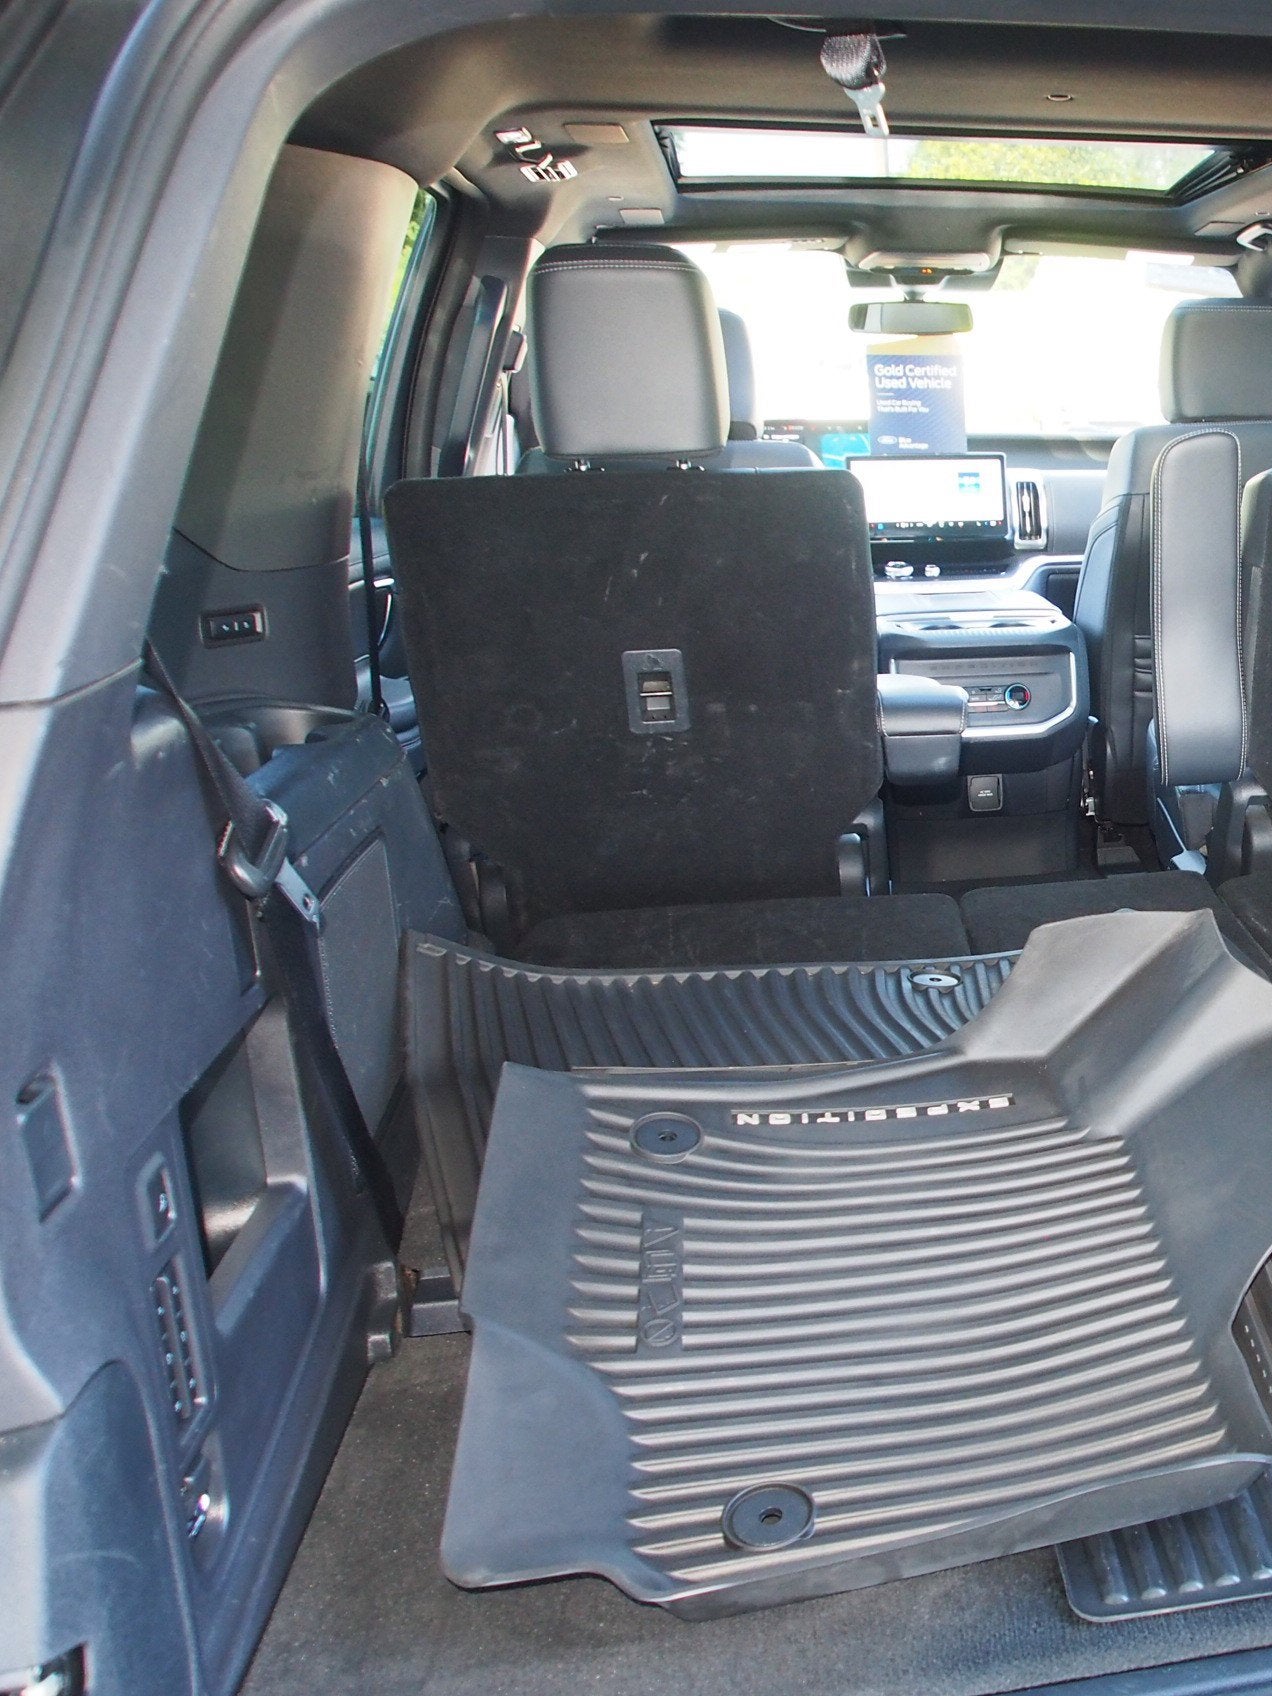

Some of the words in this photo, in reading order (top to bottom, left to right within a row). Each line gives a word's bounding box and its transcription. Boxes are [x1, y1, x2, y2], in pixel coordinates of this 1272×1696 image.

[874, 364, 904, 376] Gold
[905, 364, 957, 377] Certified
[875, 377, 907, 388] Used
[908, 377, 952, 389] Vehicle
[737, 1097, 1010, 1125] EXPEDITION
